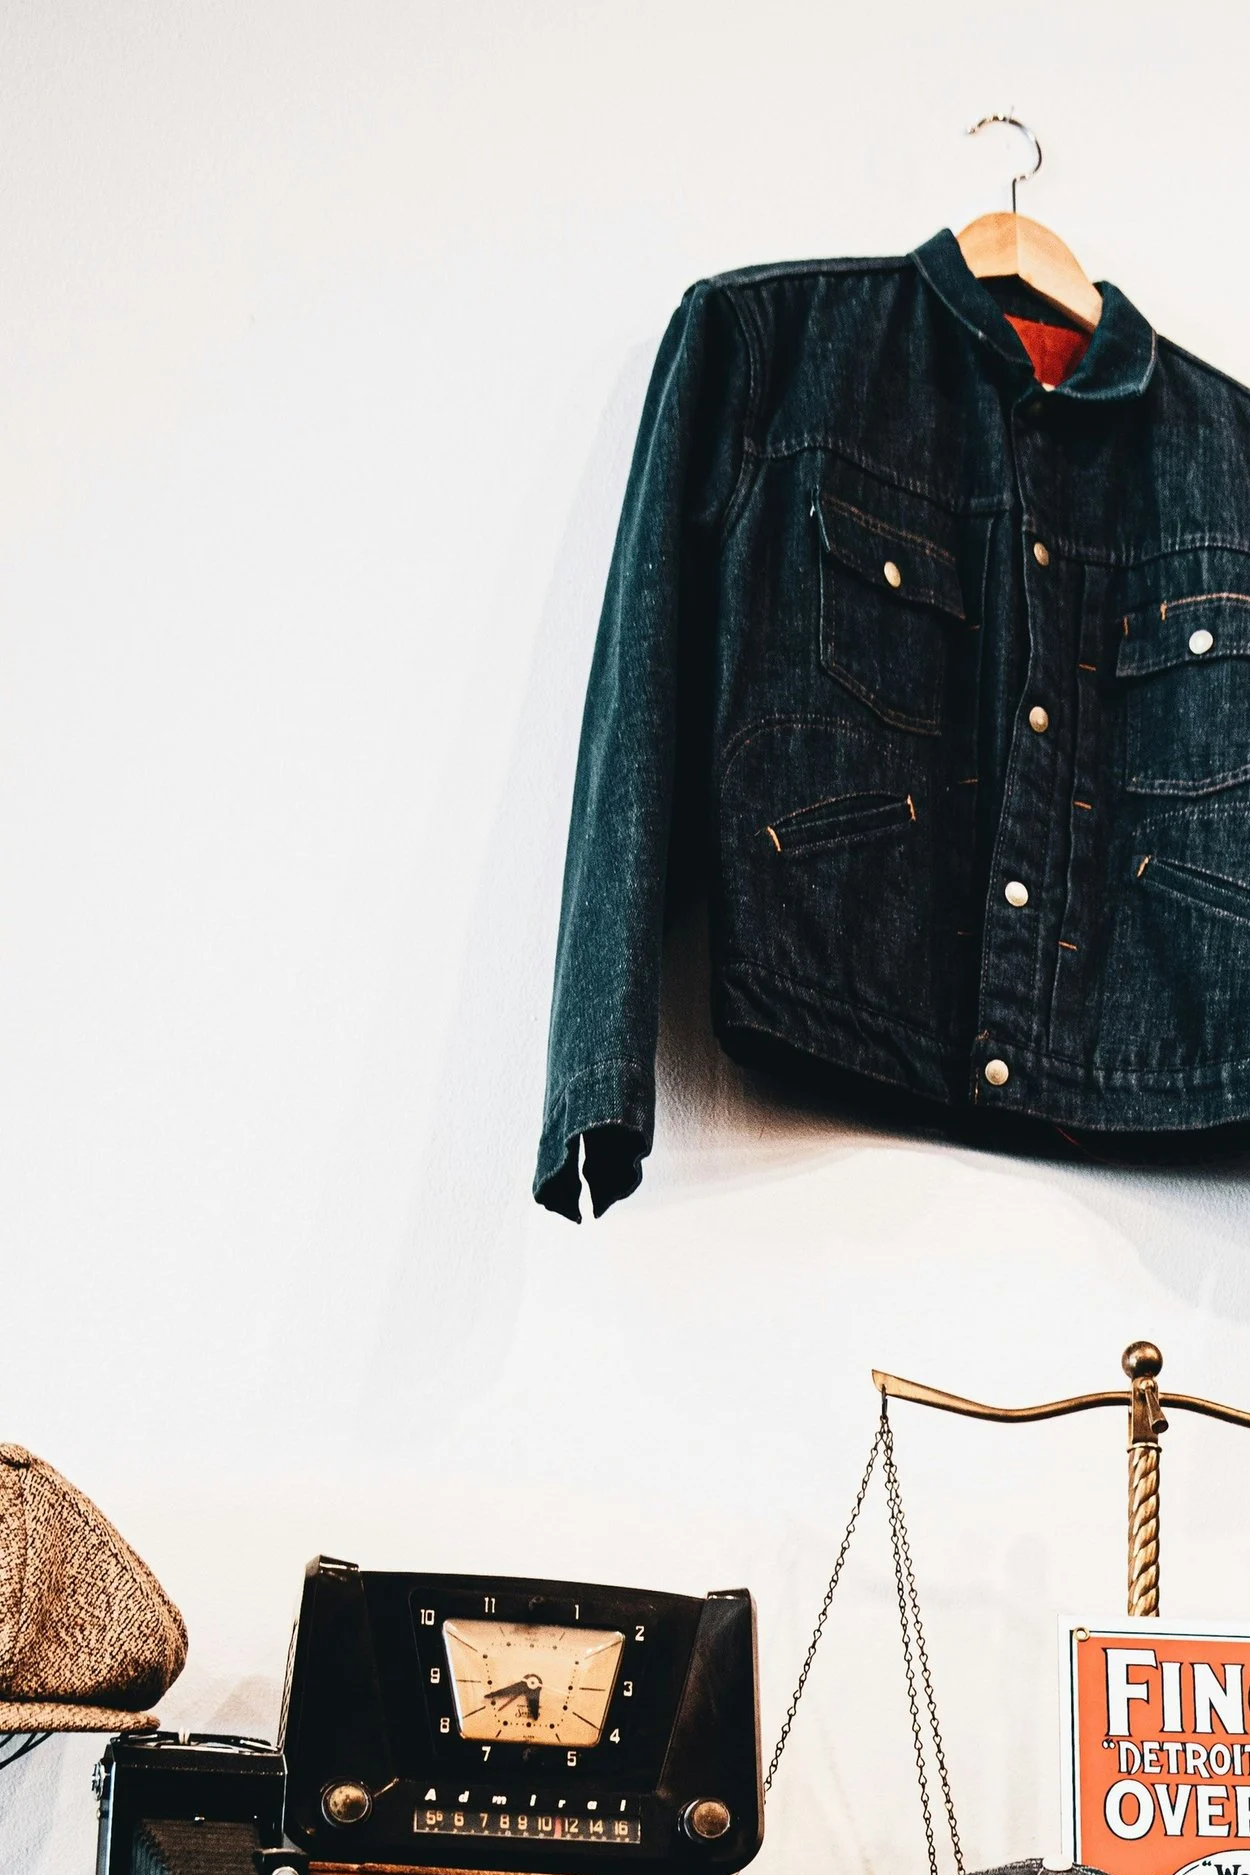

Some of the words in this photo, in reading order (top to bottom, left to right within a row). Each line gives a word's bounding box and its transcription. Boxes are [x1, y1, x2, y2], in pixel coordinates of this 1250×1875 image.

[484, 1597, 495, 1613] 11
[575, 1605, 579, 1619] 1
[420, 1609, 435, 1625] 10
[635, 1626, 644, 1641] 2
[431, 1668, 440, 1683] 9
[623, 1681, 633, 1697] 3
[440, 1718, 449, 1733] 8
[610, 1729, 620, 1744] 4
[482, 1746, 490, 1762] 7
[567, 1751, 576, 1766] 5
[424, 1788, 626, 1812] Admiral
[480, 1813, 488, 1828] 7
[500, 1814, 509, 1829] 8
[518, 1815, 528, 1829] 9
[538, 1816, 552, 1830] 10
[564, 1818, 579, 1833] 12
[589, 1820, 604, 1834] 14
[614, 1821, 628, 1835] 16
